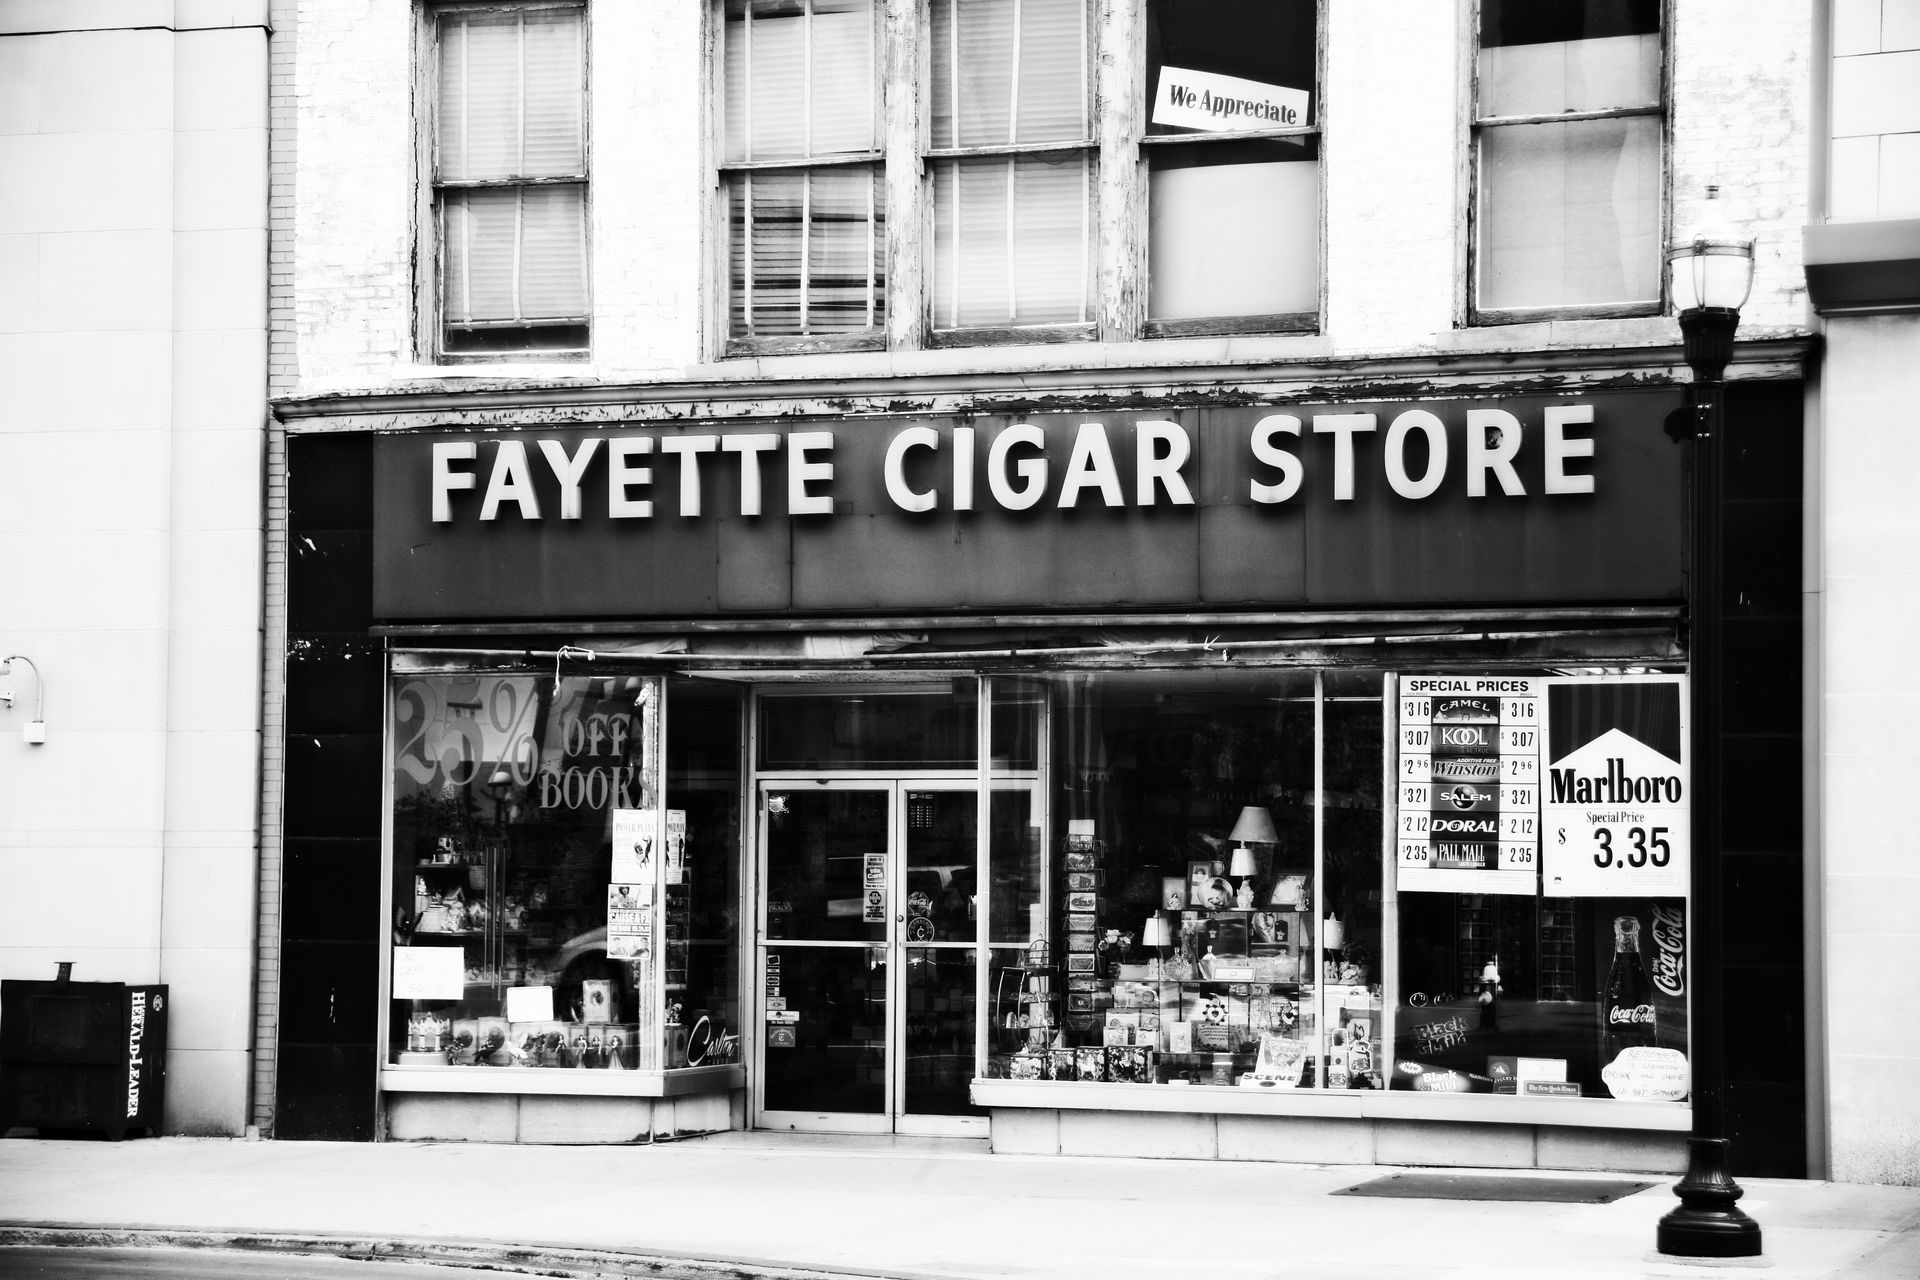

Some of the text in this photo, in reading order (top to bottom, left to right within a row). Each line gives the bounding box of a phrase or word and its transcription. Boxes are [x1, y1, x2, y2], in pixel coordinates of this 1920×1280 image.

[1170, 84, 1297, 124] We Appreciate
[432, 404, 1596, 522] FAYETTE CIGAR STORE
[1410, 680, 1529, 692] SPECIAL PRICES
[1440, 699, 1490, 712] CAMEL
[394, 678, 539, 786] 25%
[563, 713, 631, 758] OFF
[1441, 726, 1488, 746] KOOL
[1433, 761, 1499, 777] Winston
[538, 765, 658, 810] BOOKS
[1549, 757, 1682, 804] Marlboro
[1440, 792, 1492, 801] SALEM
[1431, 819, 1497, 833] DORAL
[1586, 811, 1645, 825] Special Price
[1438, 843, 1485, 862] PALL MALL
[1558, 826, 1671, 869] $ 3.35
[1652, 902, 1684, 997] Coca-Cola
[1610, 1004, 1656, 1024] Coca-Cola
[127, 991, 146, 1119] HERALD-LEADER
[1243, 1074, 1296, 1082] SCENE
[1422, 1069, 1457, 1083] Black
[1430, 1080, 1457, 1092] Mild
